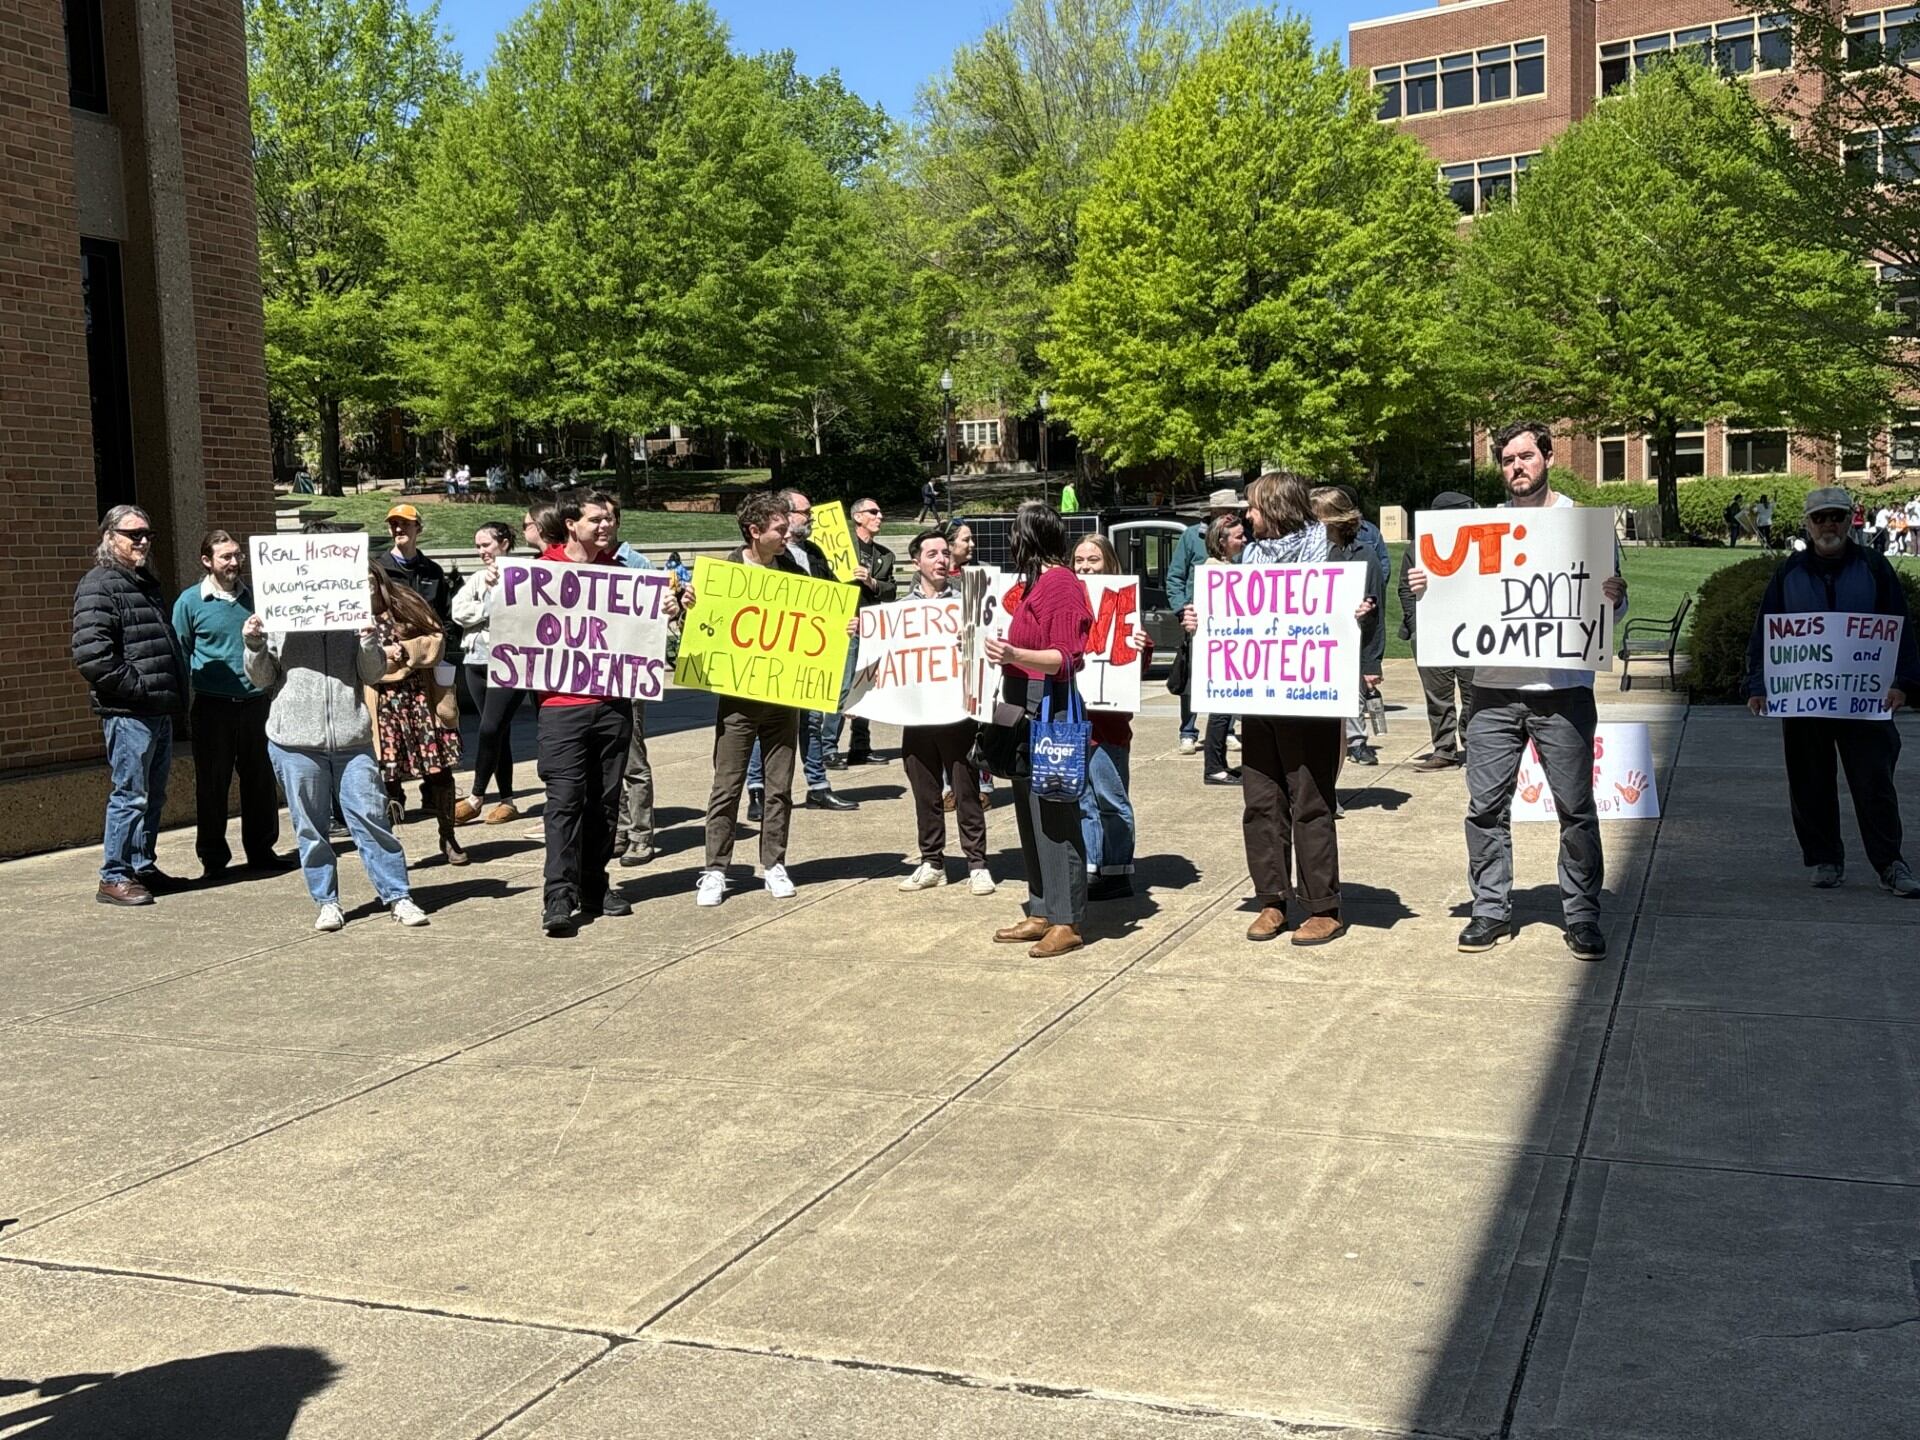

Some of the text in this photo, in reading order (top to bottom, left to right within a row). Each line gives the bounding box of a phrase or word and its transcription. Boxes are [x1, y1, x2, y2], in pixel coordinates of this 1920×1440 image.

[258, 540, 360, 566] REAL HISTORY
[1419, 523, 1527, 577] UT:
[338, 599, 362, 611] FOR
[503, 566, 671, 619] PROTECT
[703, 563, 850, 615] EDUCATION
[1207, 568, 1344, 617] PROTECT
[290, 610, 369, 628] THE FUTURE
[536, 612, 608, 650] OUR
[730, 605, 827, 657] CUTS
[1207, 616, 1330, 638] freedom of speech
[1452, 603, 1605, 662] COMPLY!
[1846, 616, 1899, 642] FEAR
[490, 643, 664, 698] STUDENTS
[1207, 639, 1338, 683] PROTECT
[1853, 647, 1882, 661] and
[681, 651, 837, 702] NEVER HEAL
[1207, 679, 1338, 701] freedom in academia
[1767, 698, 1788, 713] WE
[1796, 696, 1837, 713] LOVE
[1034, 737, 1075, 764] Kroger
